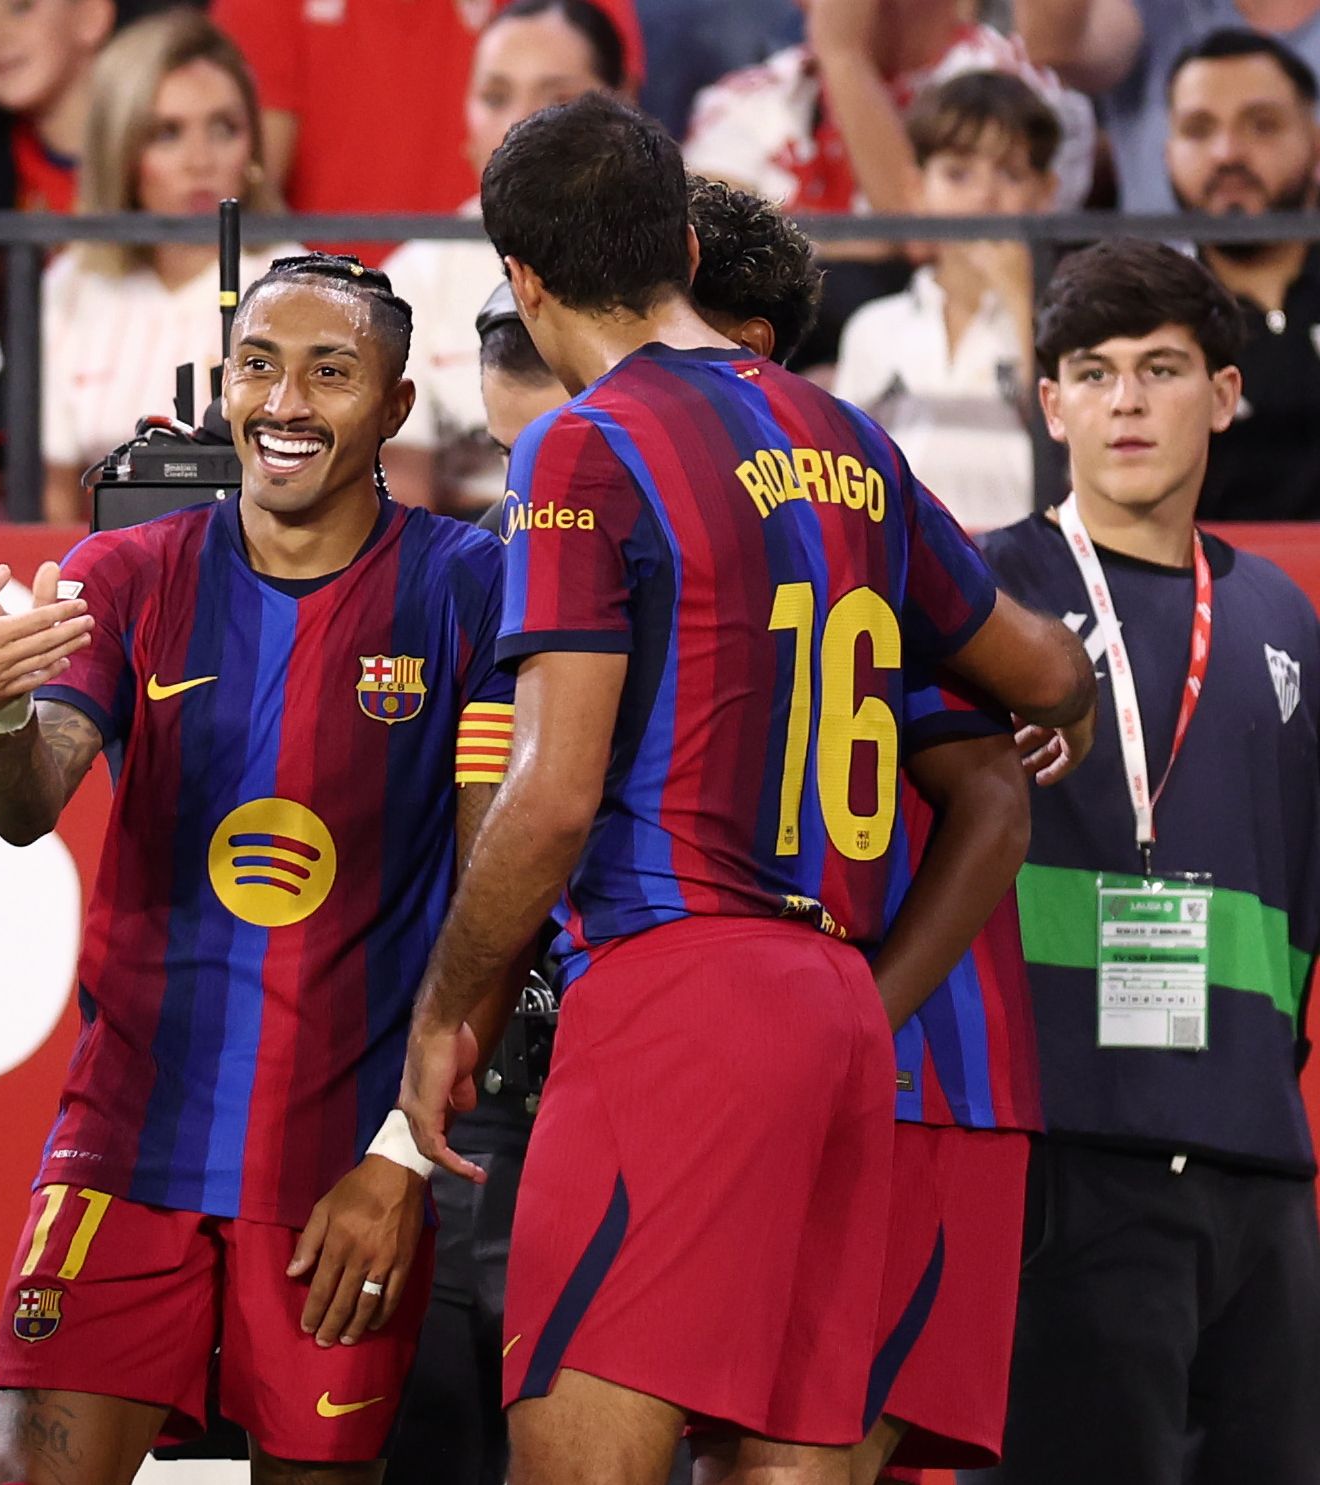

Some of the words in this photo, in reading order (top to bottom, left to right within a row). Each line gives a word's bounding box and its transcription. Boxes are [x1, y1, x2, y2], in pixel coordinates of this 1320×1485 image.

[499, 490, 595, 546] Midea
[735, 448, 886, 523] RODRIGO
[768, 581, 901, 861] 16
[20, 1184, 113, 1280] 11
